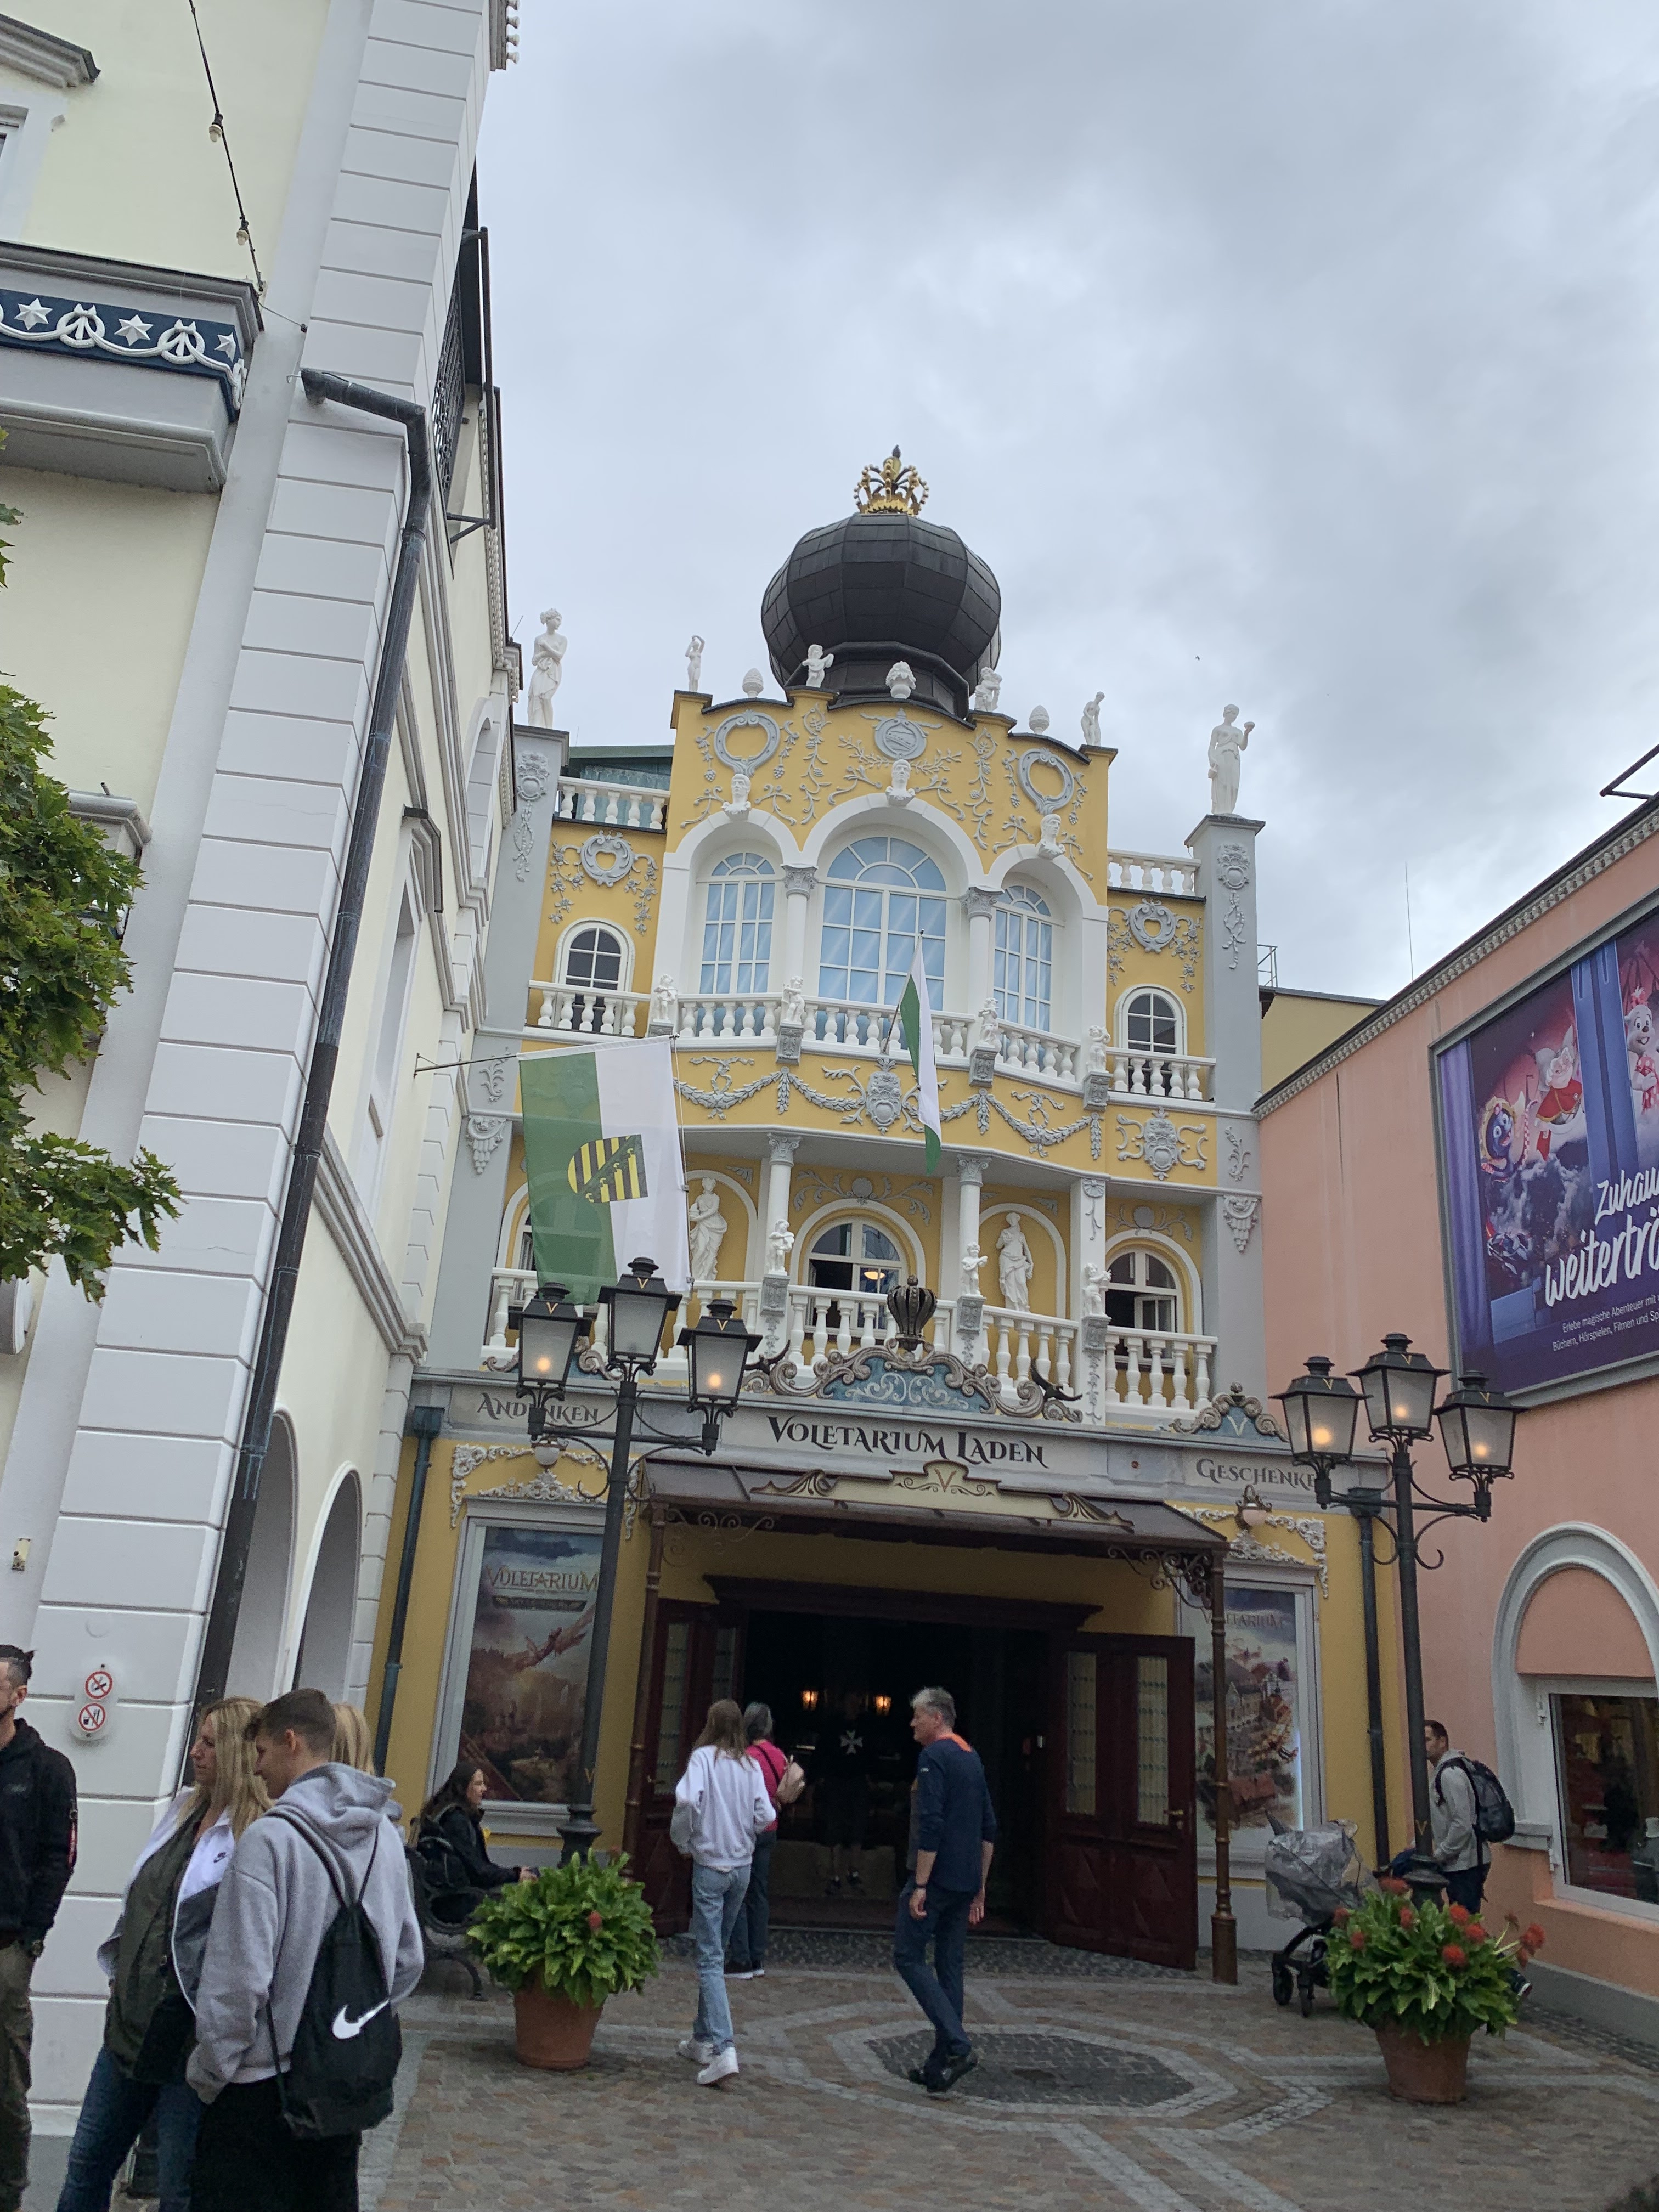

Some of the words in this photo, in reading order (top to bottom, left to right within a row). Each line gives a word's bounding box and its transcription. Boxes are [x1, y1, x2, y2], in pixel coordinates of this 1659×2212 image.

[1594, 1167, 1659, 1226] Zuhau
[1562, 1320, 1581, 1333] Erlebe
[1582, 1311, 1610, 1327] magische
[1612, 1299, 1644, 1317] Abenteuer
[1646, 1294, 1656, 1306] mit
[1613, 1319, 1635, 1333] Filmen
[1636, 1312, 1649, 1325] und
[1650, 1307, 1659, 1323] Sp
[476, 1392, 599, 1425] ANDNKEN
[1227, 1415, 1248, 1436] V
[767, 1415, 948, 1460] VOLETARIUM
[957, 1431, 1050, 1469] LADEN
[934, 1468, 957, 1493] V
[485, 1565, 600, 1592] VOLETARIUM
